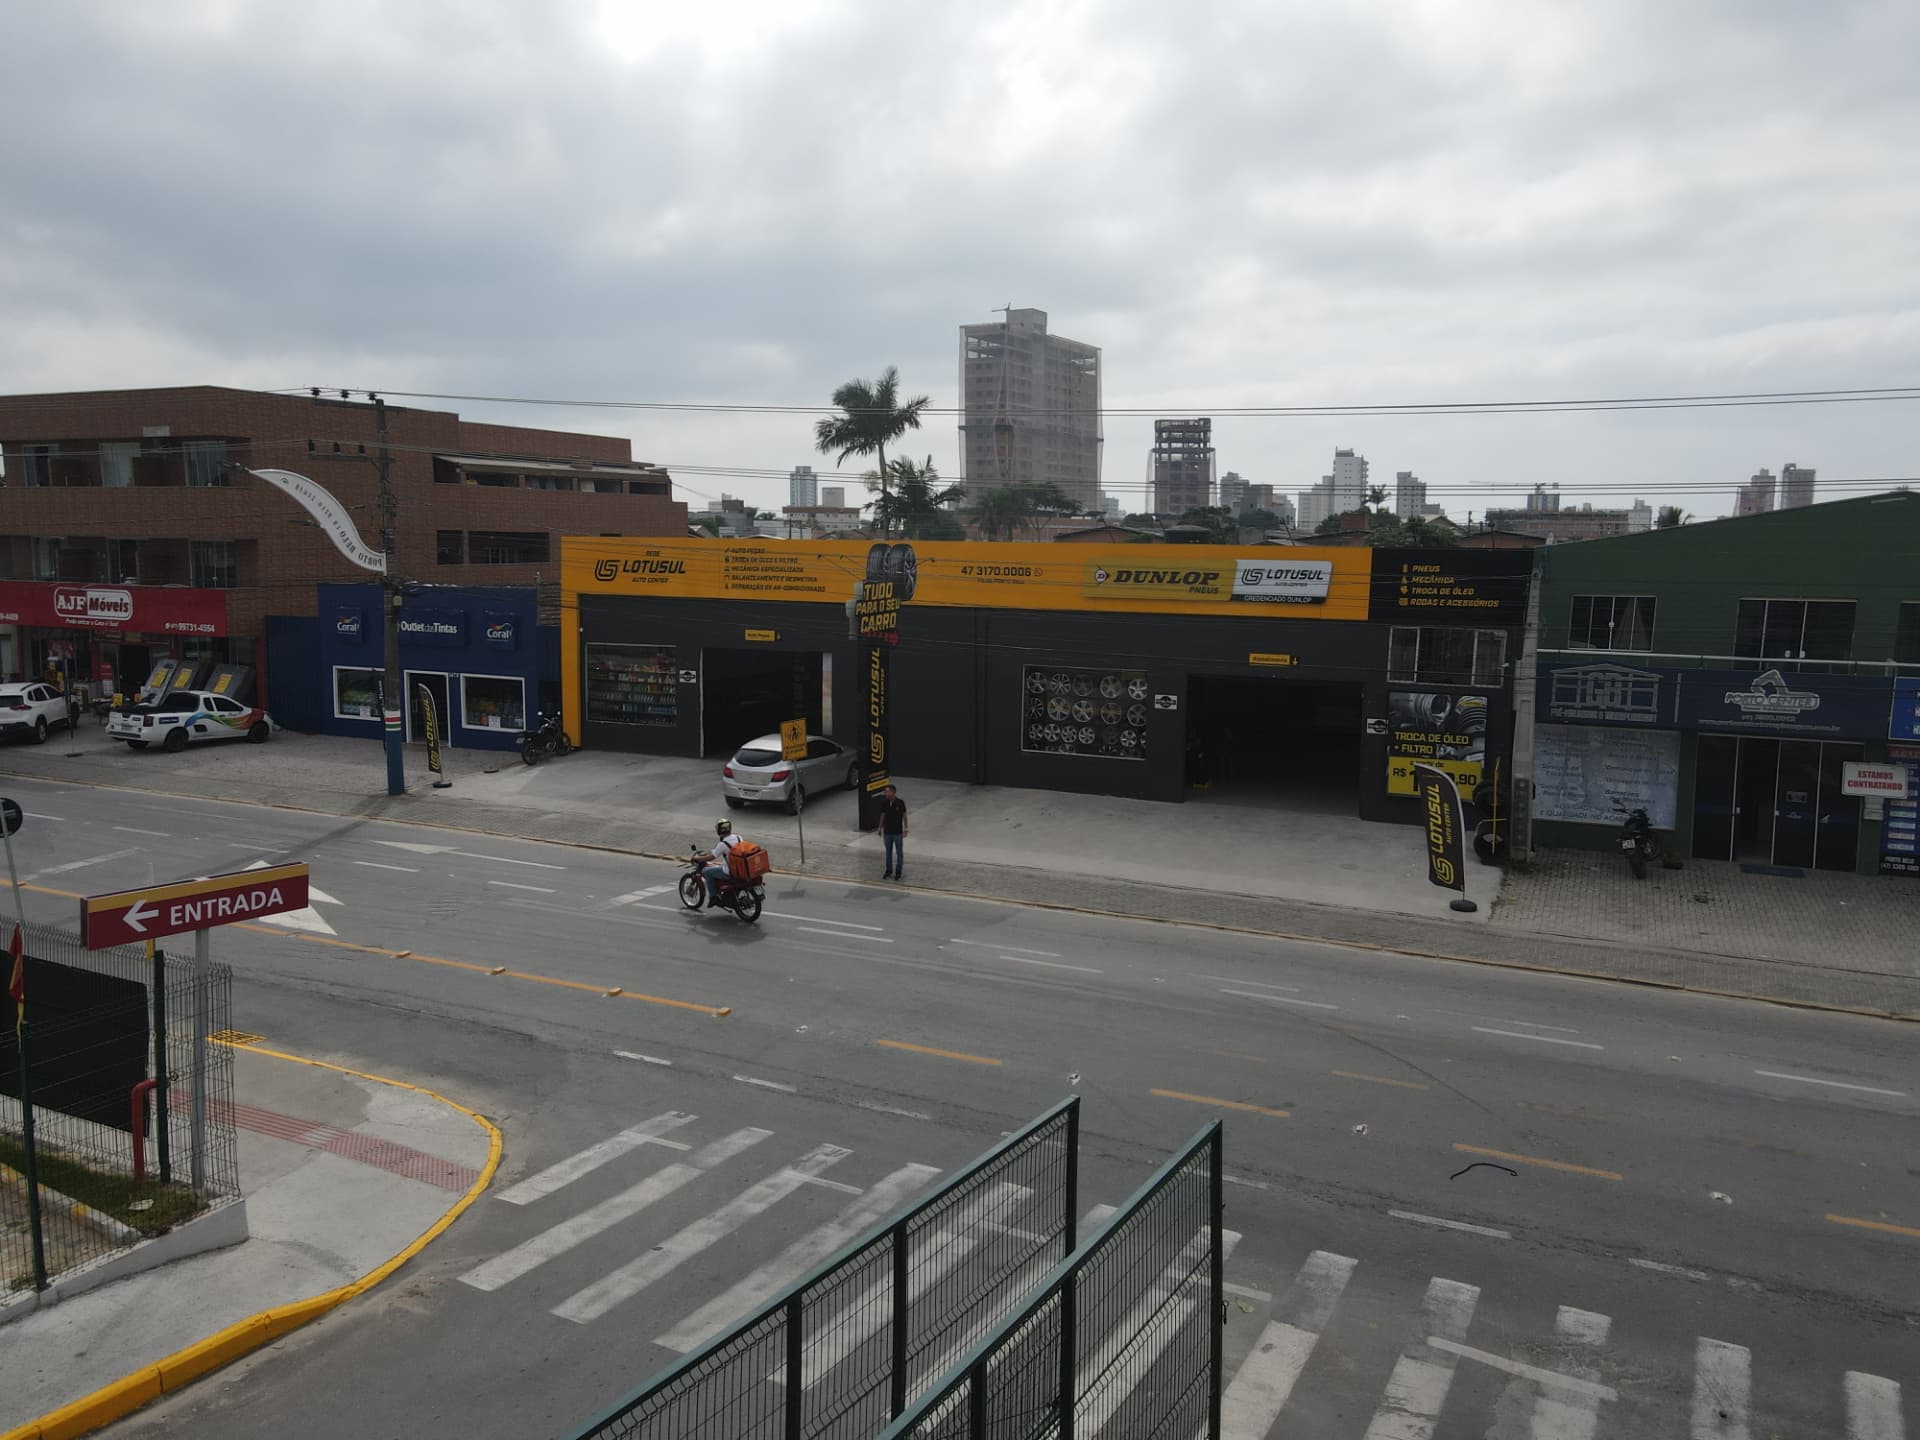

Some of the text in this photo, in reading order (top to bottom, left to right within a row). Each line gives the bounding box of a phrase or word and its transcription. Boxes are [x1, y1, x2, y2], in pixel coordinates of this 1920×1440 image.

[622, 560, 686, 574] LOTUSUL
[960, 566, 1031, 576] 47 3170.0006
[1113, 570, 1220, 586] DUNLOP
[1266, 569, 1324, 580] LOTUSUL
[1411, 575, 1456, 584] MECÂNICA
[864, 582, 893, 600] TUDO
[1188, 586, 1219, 594] PNEUS
[1452, 586, 1474, 595] ÓLEO
[57, 594, 129, 614] AJF Móveis
[1410, 598, 1438, 606] RODAS
[1446, 598, 1500, 607] ACESSÓRIOS
[856, 601, 878, 616] PARA
[879, 601, 885, 612] O
[337, 621, 357, 632] Coral
[401, 620, 424, 632] Outlet
[434, 622, 458, 634] Tintas
[860, 612, 897, 633] CARRO
[486, 628, 509, 639] Coral
[871, 648, 880, 728] LOTUSUL
[1726, 692, 1814, 707] PORTO CENTER
[1394, 732, 1468, 744] TROCA DE ÓLEO
[1402, 744, 1433, 754] FILTRO
[1392, 768, 1406, 778] R$
[1858, 770, 1894, 780] ESTAMOS
[1848, 780, 1903, 791] CONTRATANDO
[1426, 784, 1444, 854] LOTUSUL
[170, 886, 284, 926] ENTRADA
